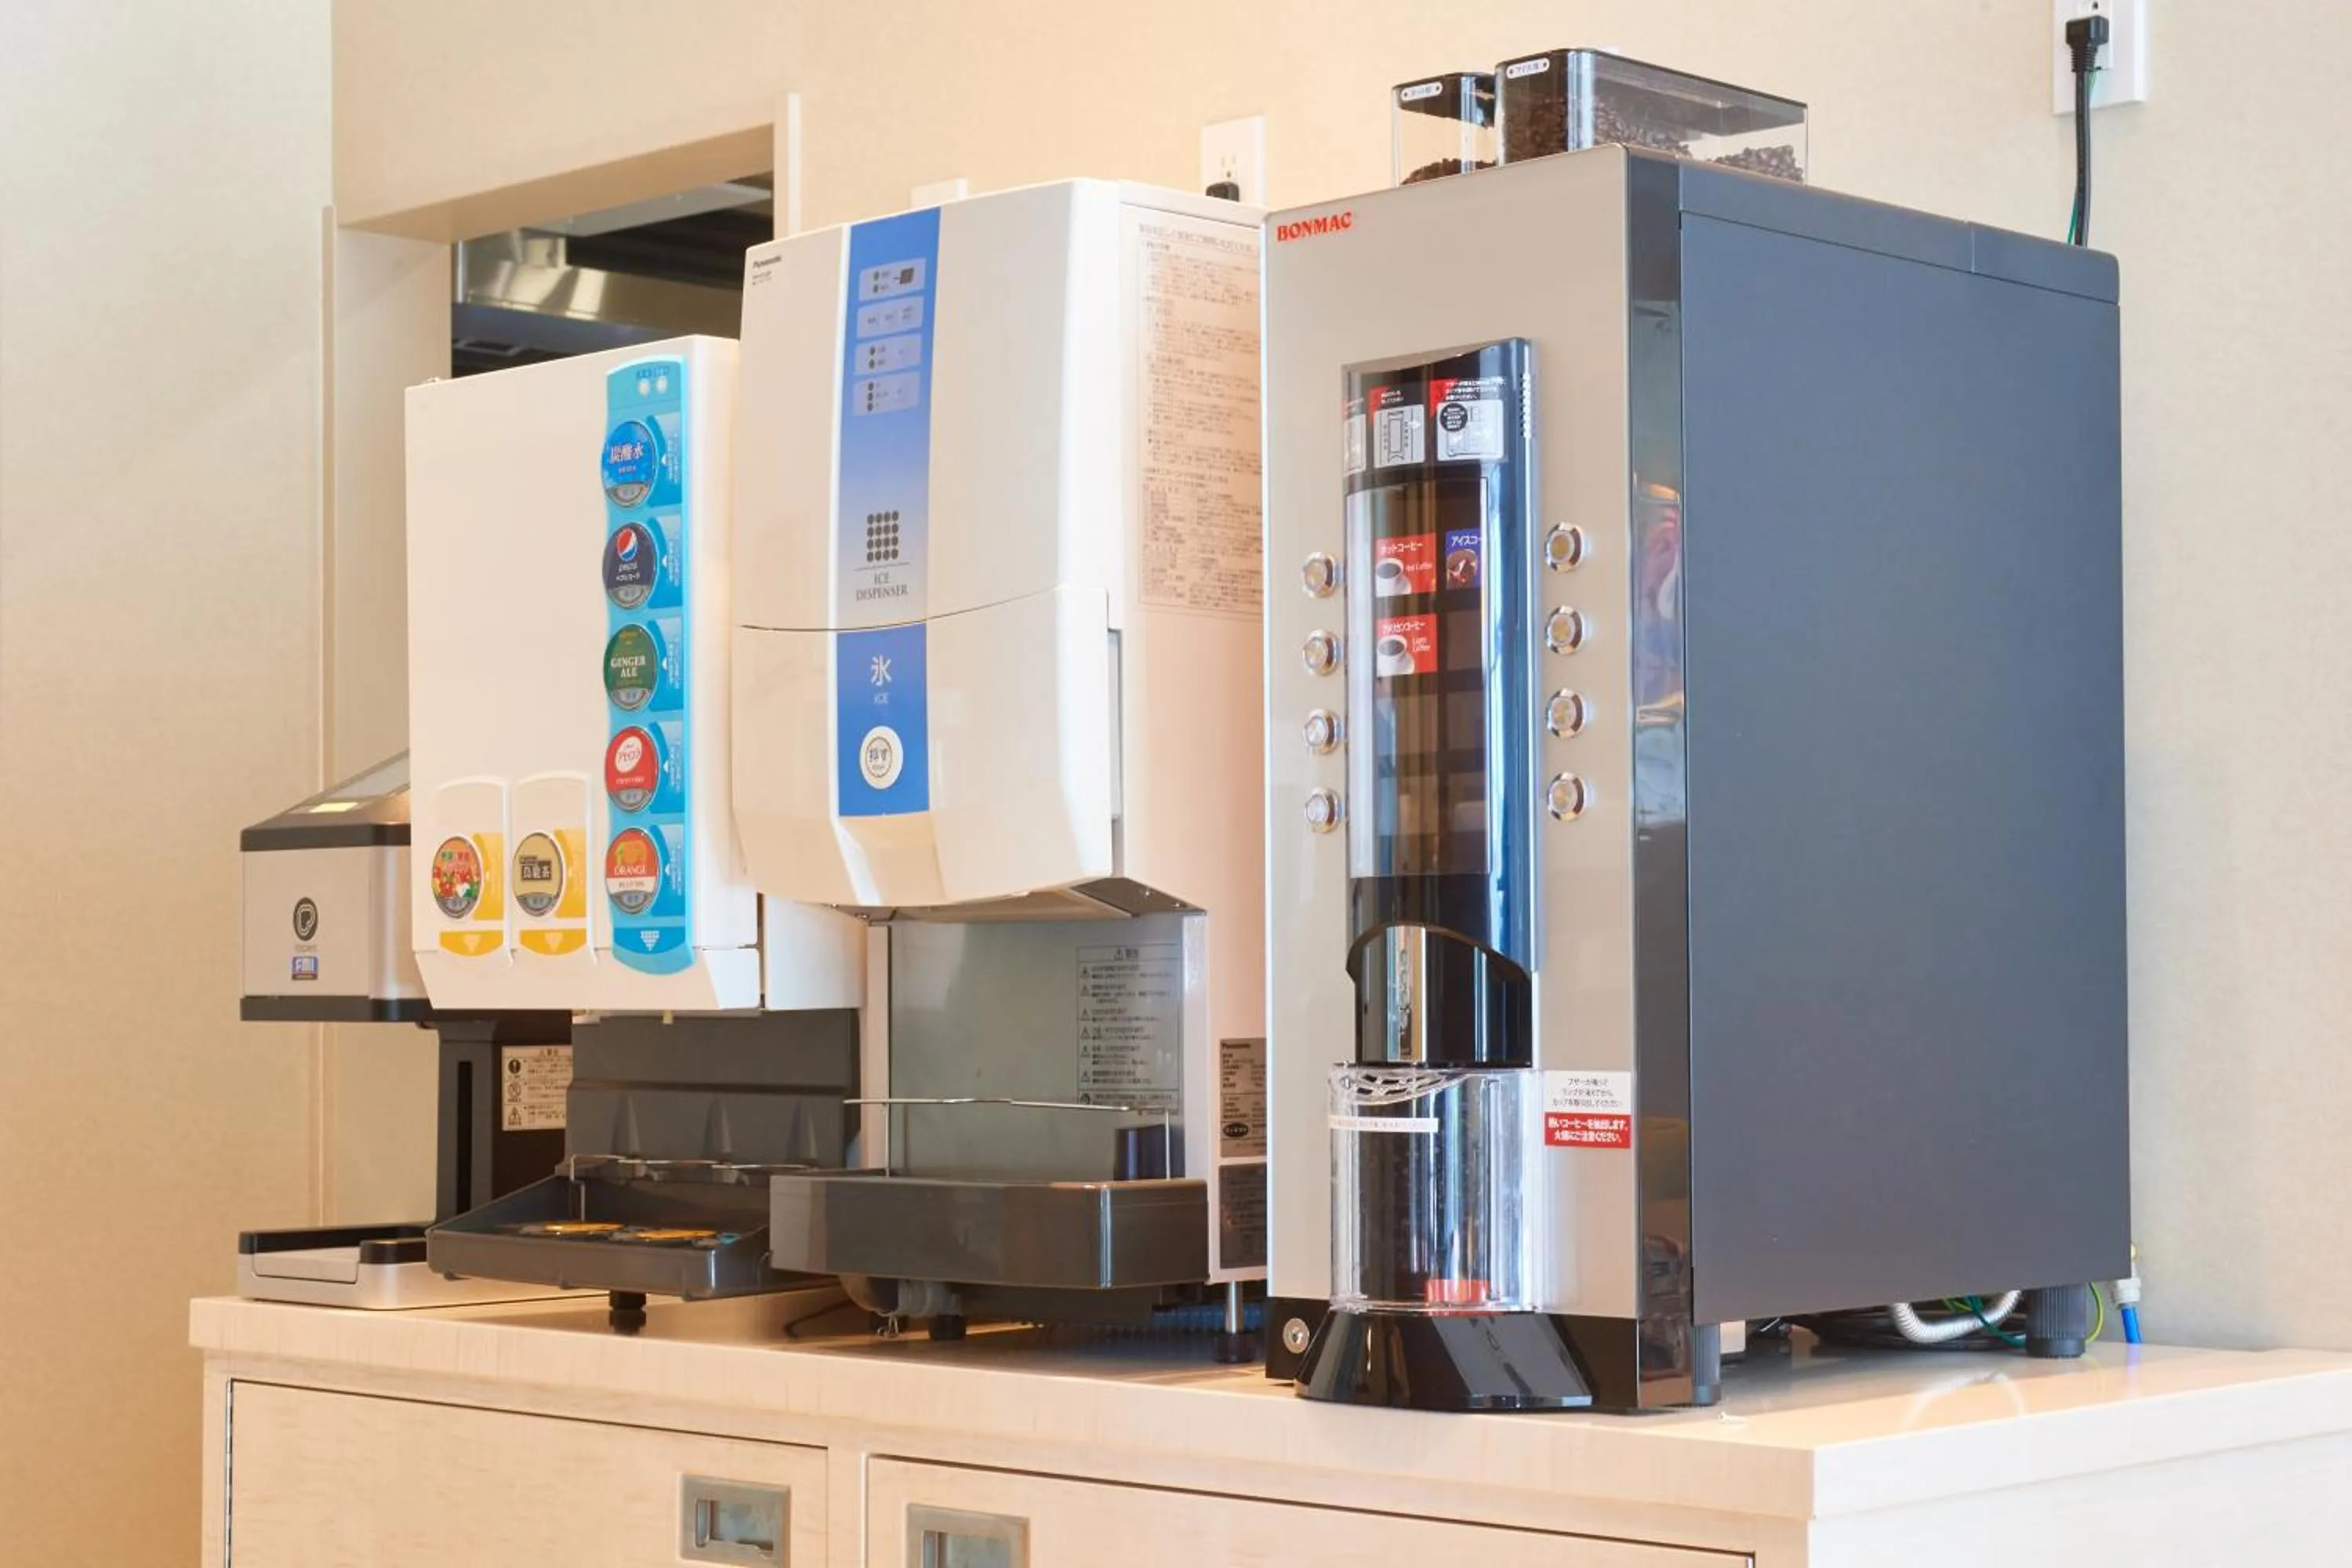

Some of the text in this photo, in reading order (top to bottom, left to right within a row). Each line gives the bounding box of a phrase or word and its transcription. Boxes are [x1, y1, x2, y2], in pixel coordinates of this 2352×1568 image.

[1277, 211, 1352, 242] BONMAC
[608, 441, 644, 464] 炭酸水
[1381, 541, 1424, 556] ホットコーヒー
[874, 572, 891, 584] ICE
[856, 584, 908, 601] DISPENSER
[611, 655, 645, 669] GINGER
[620, 667, 638, 678] ALE
[871, 655, 891, 686] 氷
[614, 864, 647, 877] ORANGE
